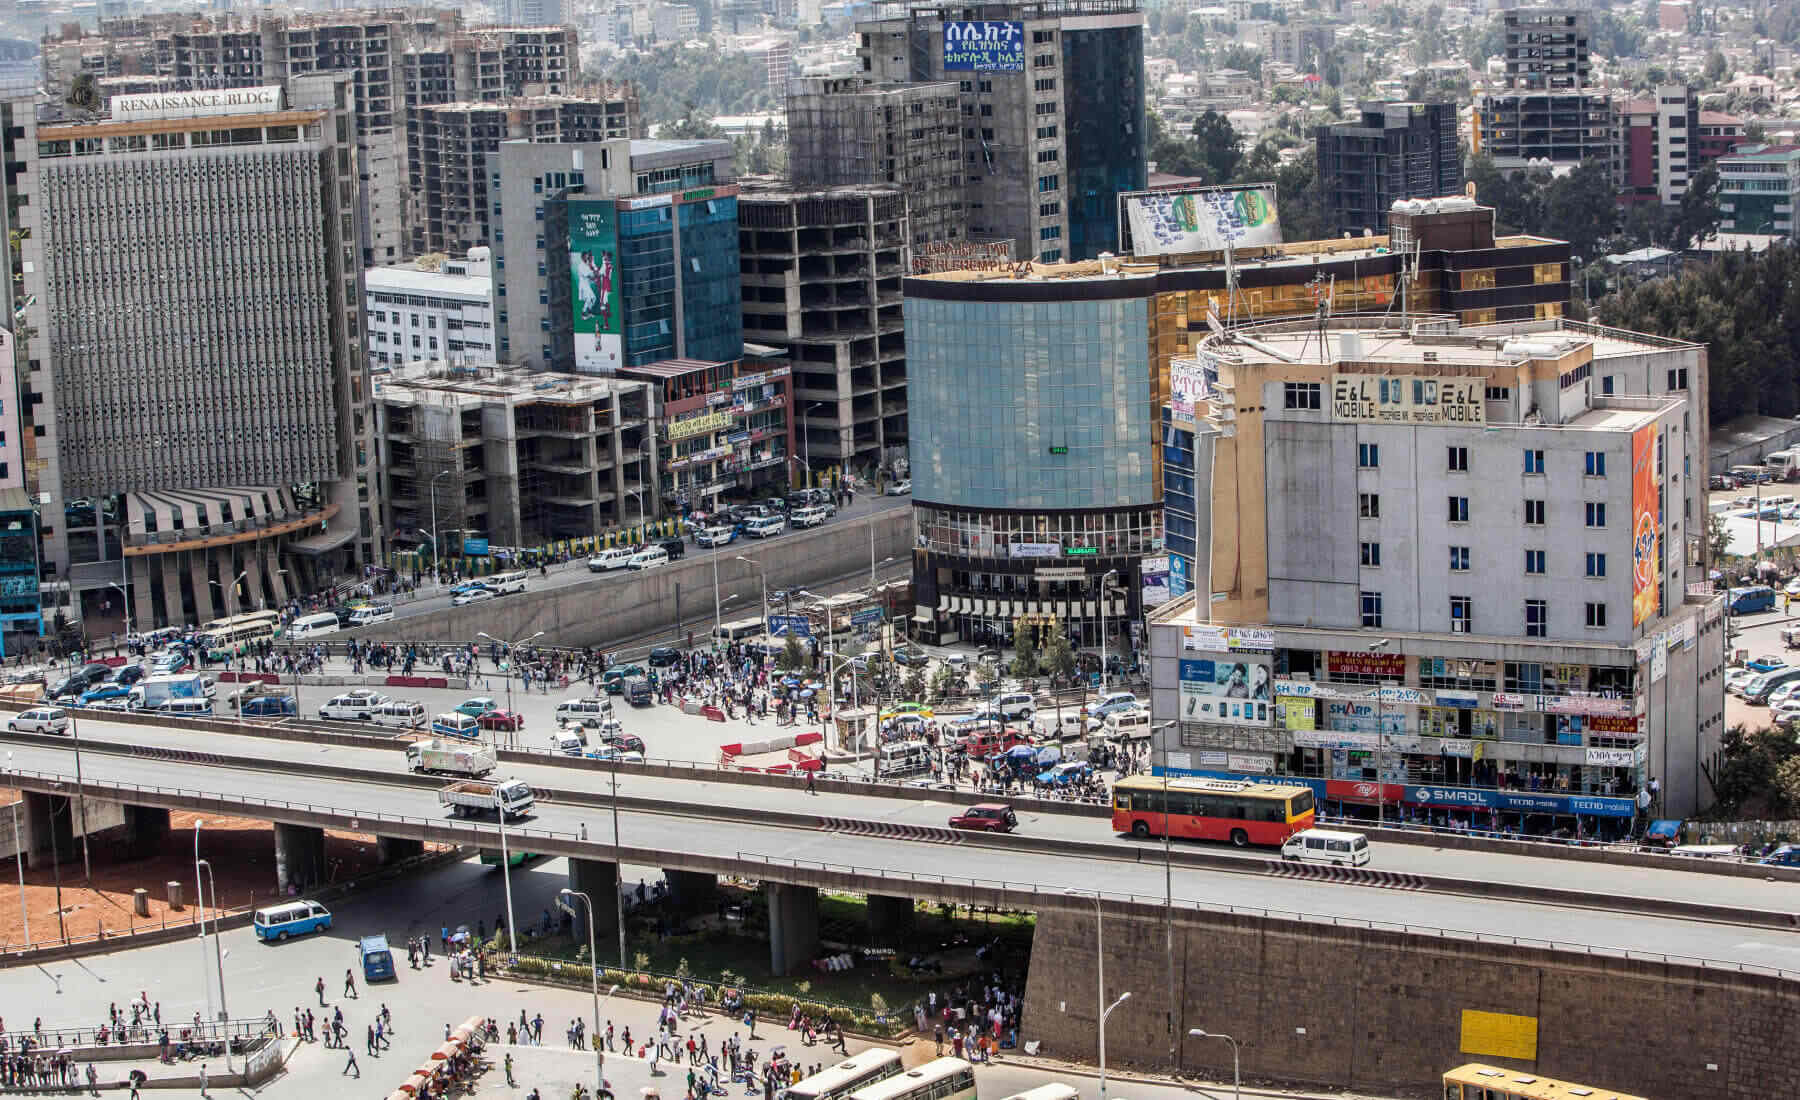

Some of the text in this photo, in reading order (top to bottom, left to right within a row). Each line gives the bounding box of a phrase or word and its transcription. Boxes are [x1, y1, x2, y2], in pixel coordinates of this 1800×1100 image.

[120, 95, 221, 111] RENAISSANCE
[1335, 402, 1375, 418] MOBILE
[1442, 406, 1481, 422] MOBILE
[1329, 701, 1372, 714] SHARP
